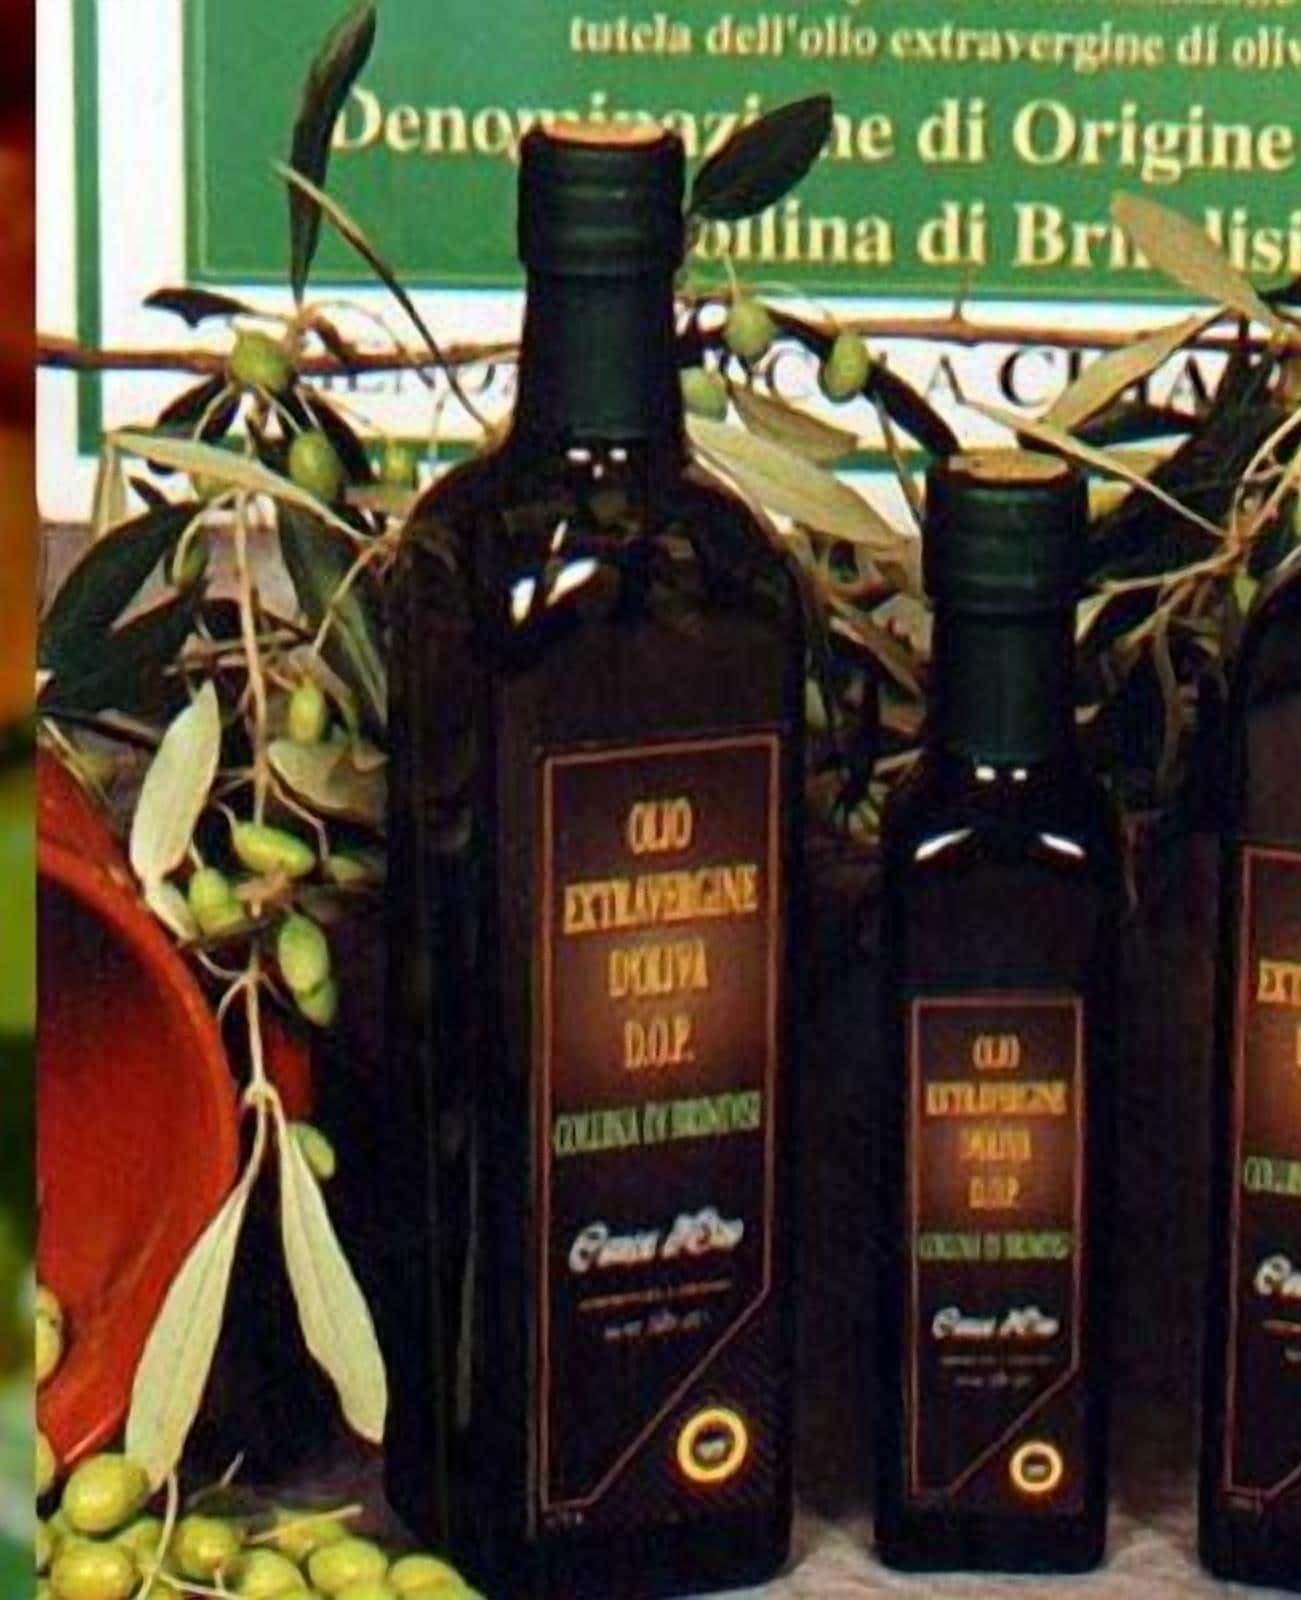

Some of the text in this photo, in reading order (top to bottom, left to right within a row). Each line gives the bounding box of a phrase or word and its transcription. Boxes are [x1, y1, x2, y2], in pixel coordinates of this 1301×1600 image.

[569, 13, 693, 55] tutela
[706, 13, 879, 59] dell'olio
[891, 22, 1165, 74] extravergine
[1177, 24, 1219, 67] di
[916, 97, 987, 163] di
[1012, 98, 1296, 183] Origine
[916, 199, 988, 265] di
[628, 797, 693, 856] OLIO
[563, 864, 760, 935] EXTRAVERGINE
[608, 937, 710, 998] D'OLIVA
[623, 1015, 696, 1071] D.O.P.
